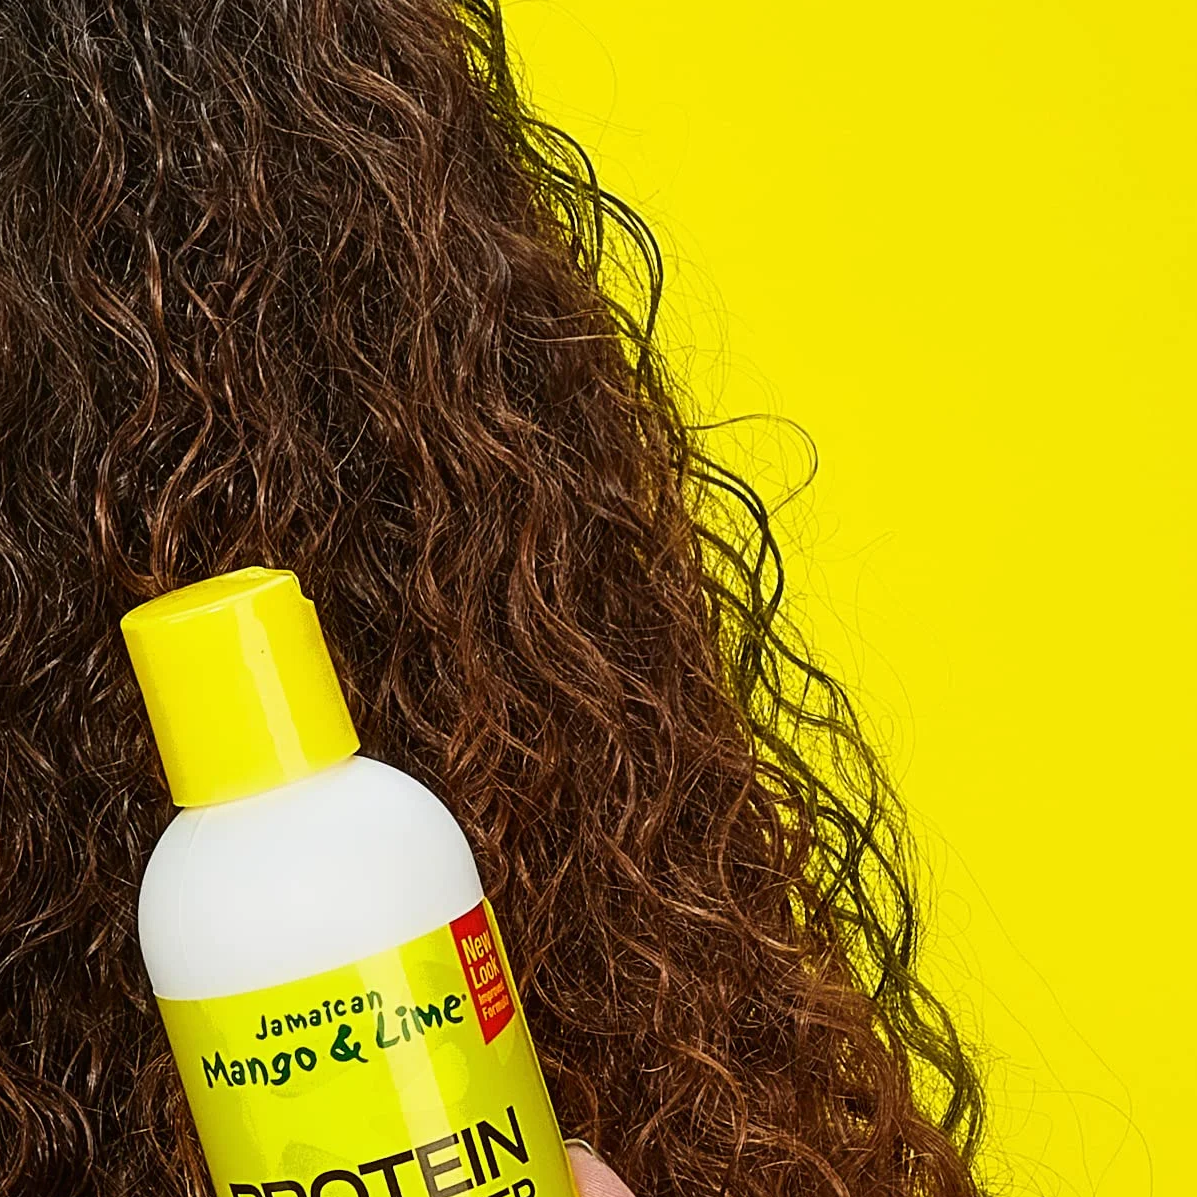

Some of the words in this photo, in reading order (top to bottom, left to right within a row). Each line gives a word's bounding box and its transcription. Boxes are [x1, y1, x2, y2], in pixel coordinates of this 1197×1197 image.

[461, 929, 492, 965] New
[469, 954, 500, 989] Look
[255, 990, 383, 1040] Jamaican
[201, 1047, 317, 1088] Mango
[330, 1024, 369, 1063] &
[376, 994, 464, 1049] Lime
